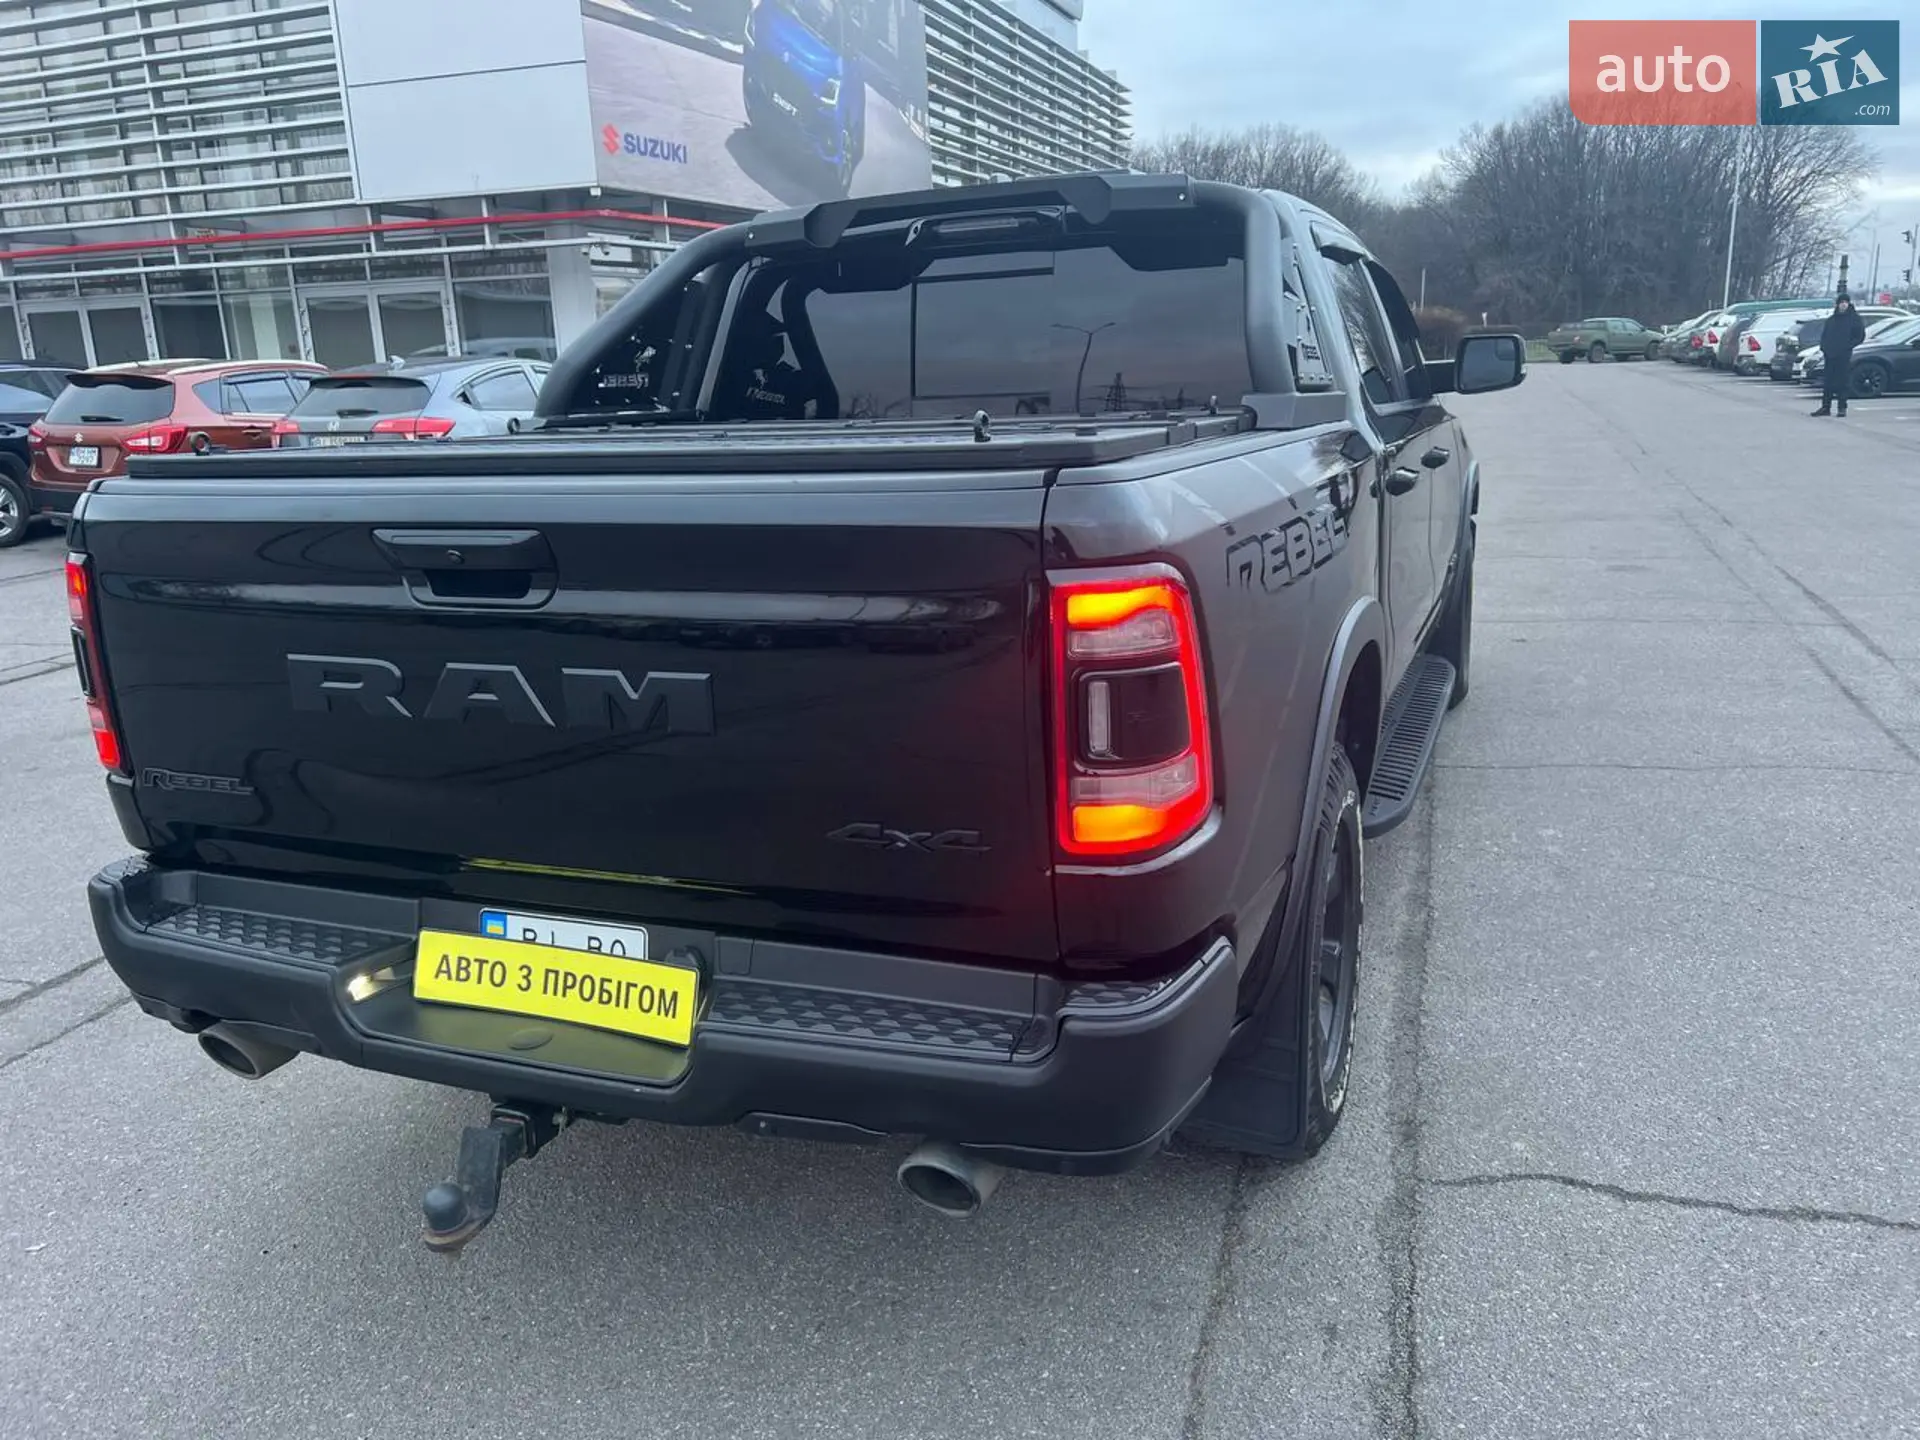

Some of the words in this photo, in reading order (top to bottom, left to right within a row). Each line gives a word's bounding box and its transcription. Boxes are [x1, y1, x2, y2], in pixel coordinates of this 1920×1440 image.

[623, 132, 688, 164] SUZUKI
[1226, 506, 1350, 593] REBEL
[287, 653, 713, 735] RAM
[434, 954, 507, 988] АВТО
[542, 968, 678, 1019] ПРОБІГОМ
